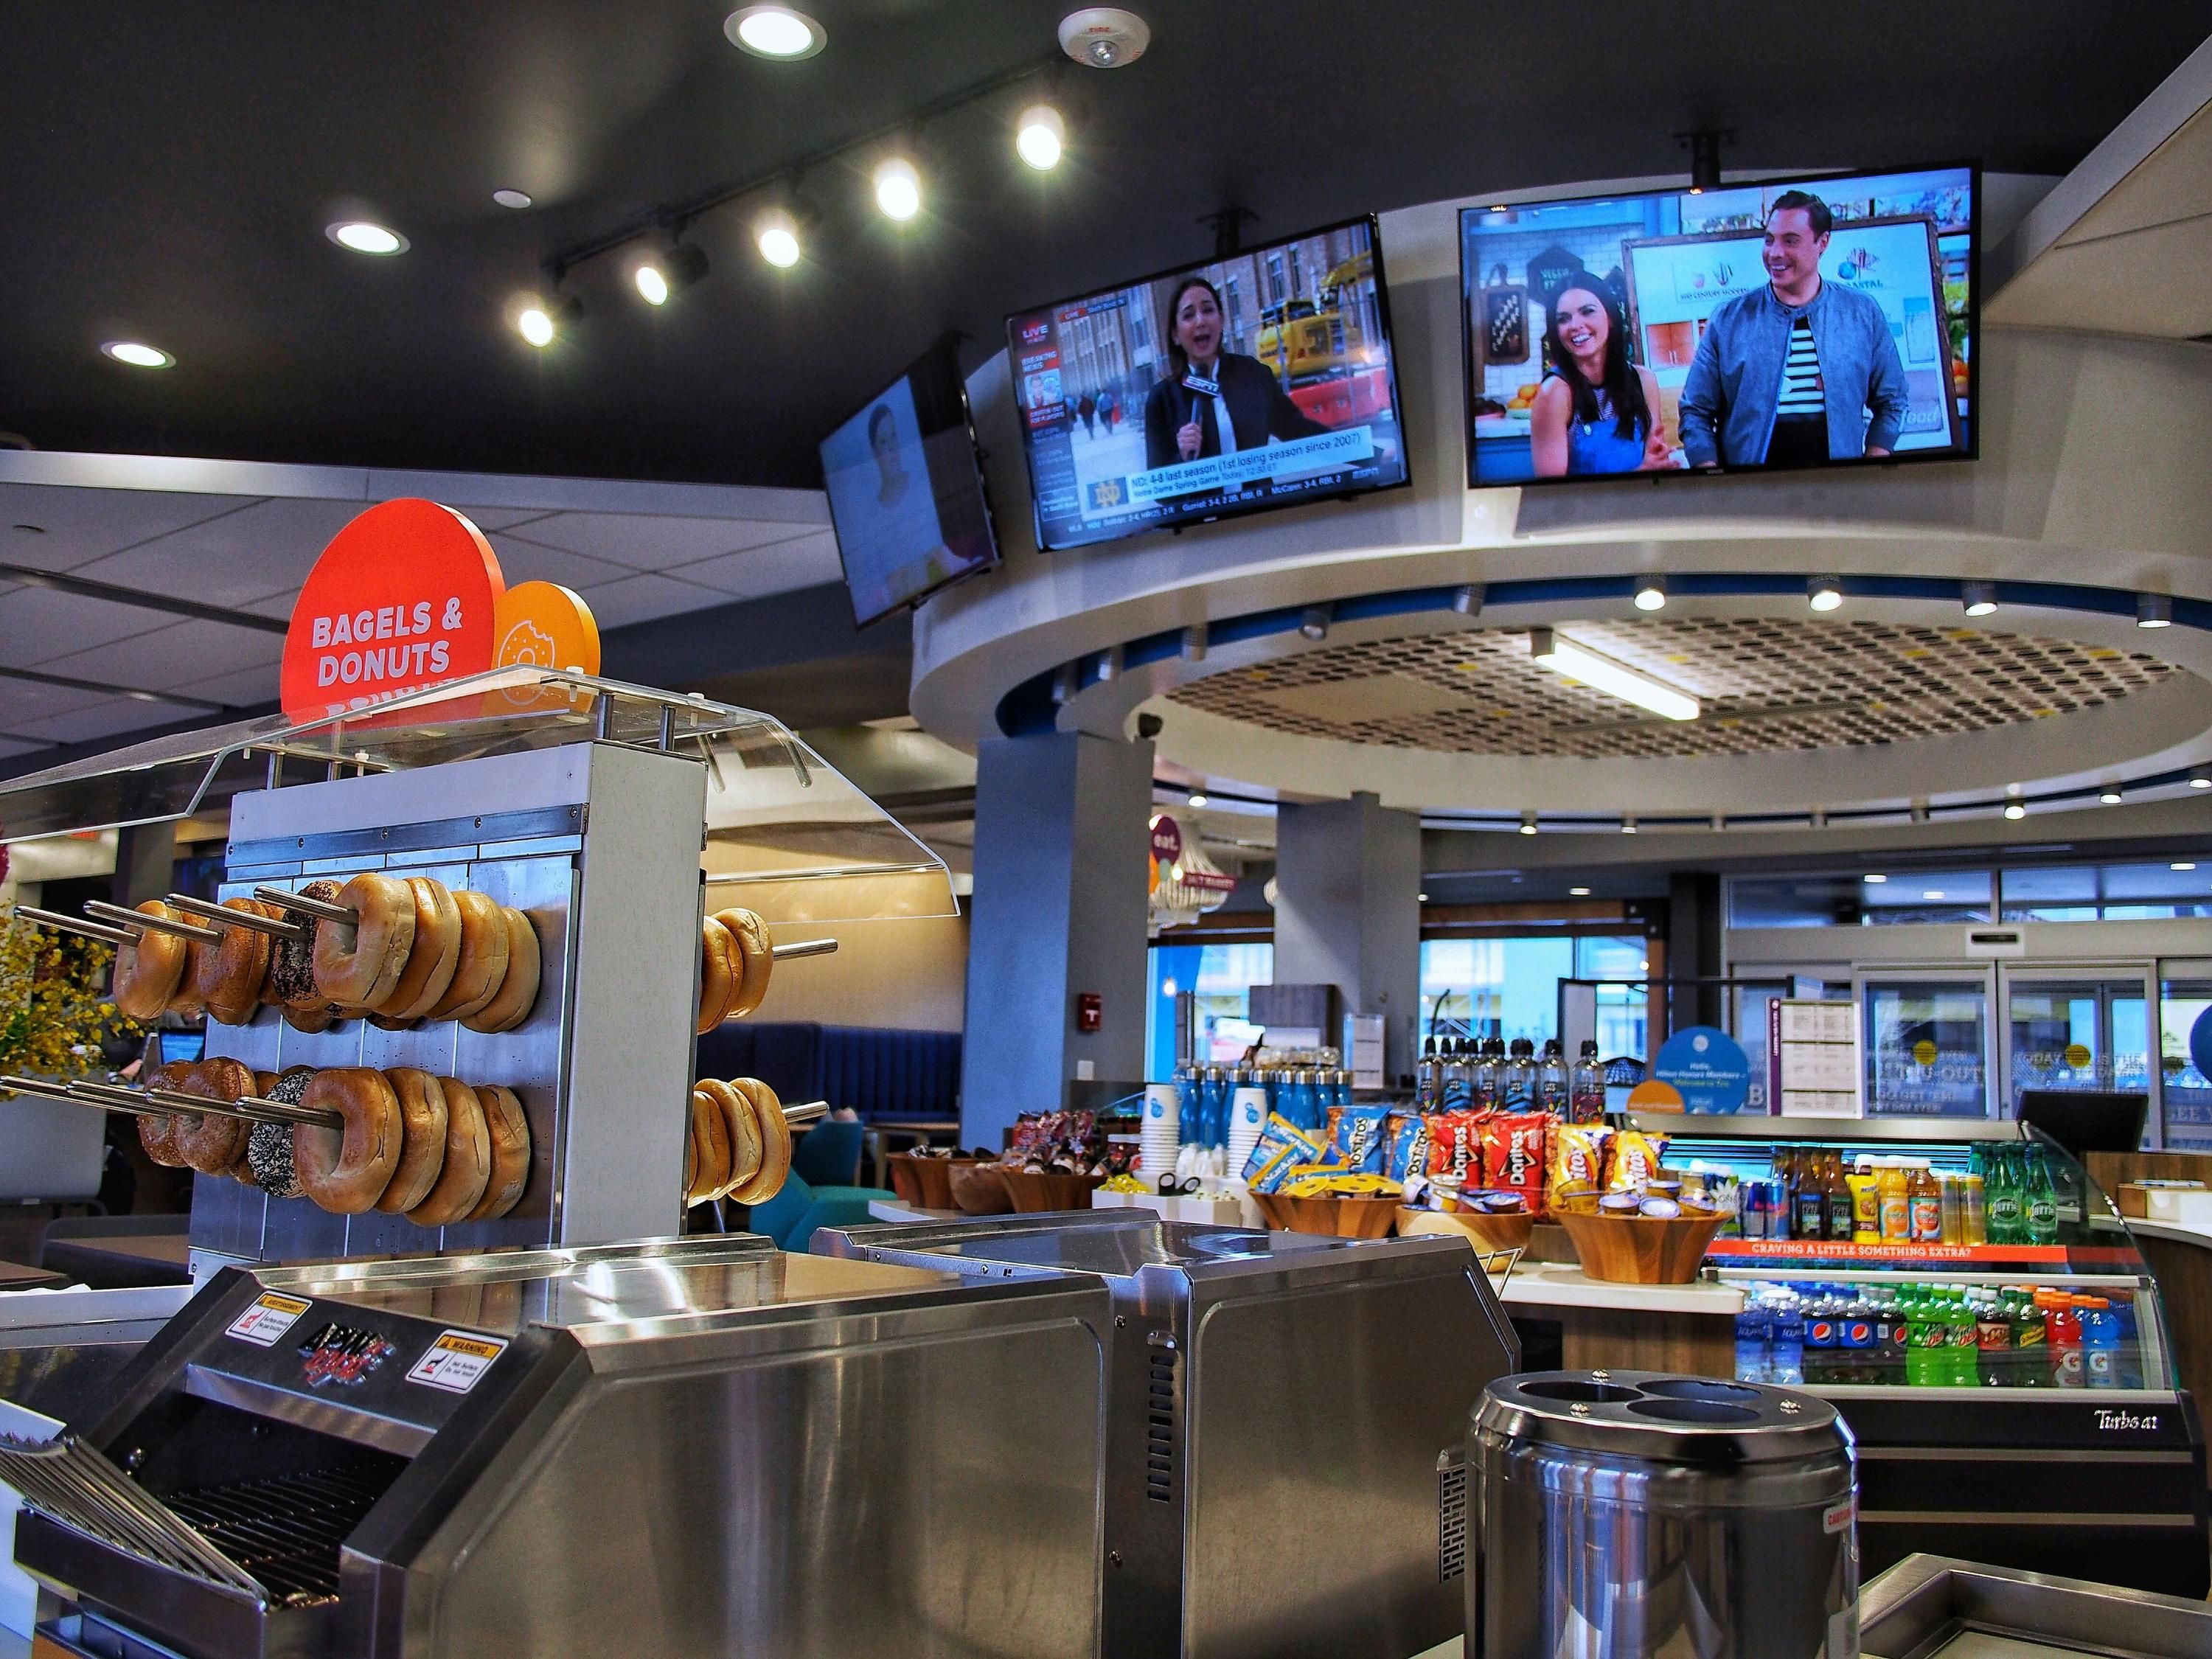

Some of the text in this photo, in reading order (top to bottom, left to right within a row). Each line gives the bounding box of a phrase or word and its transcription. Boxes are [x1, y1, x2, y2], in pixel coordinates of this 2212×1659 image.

[1023, 324, 1048, 339] LIVE
[1166, 467, 1182, 480] last
[1183, 463, 1215, 478] season
[1218, 458, 1236, 472] (1st
[1237, 451, 1267, 468] losing
[1268, 447, 1304, 461] season
[1306, 439, 1331, 454] since
[1333, 432, 1361, 448] 2007)
[313, 597, 463, 648] BAGELS &
[318, 640, 450, 687] DONUTS
[1751, 1243, 1972, 1258] CRAVING A LITTLE SOMETHING EXTRA?
[453, 1340, 489, 1354] WARNING
[2094, 1409, 2140, 1430] Turbo
